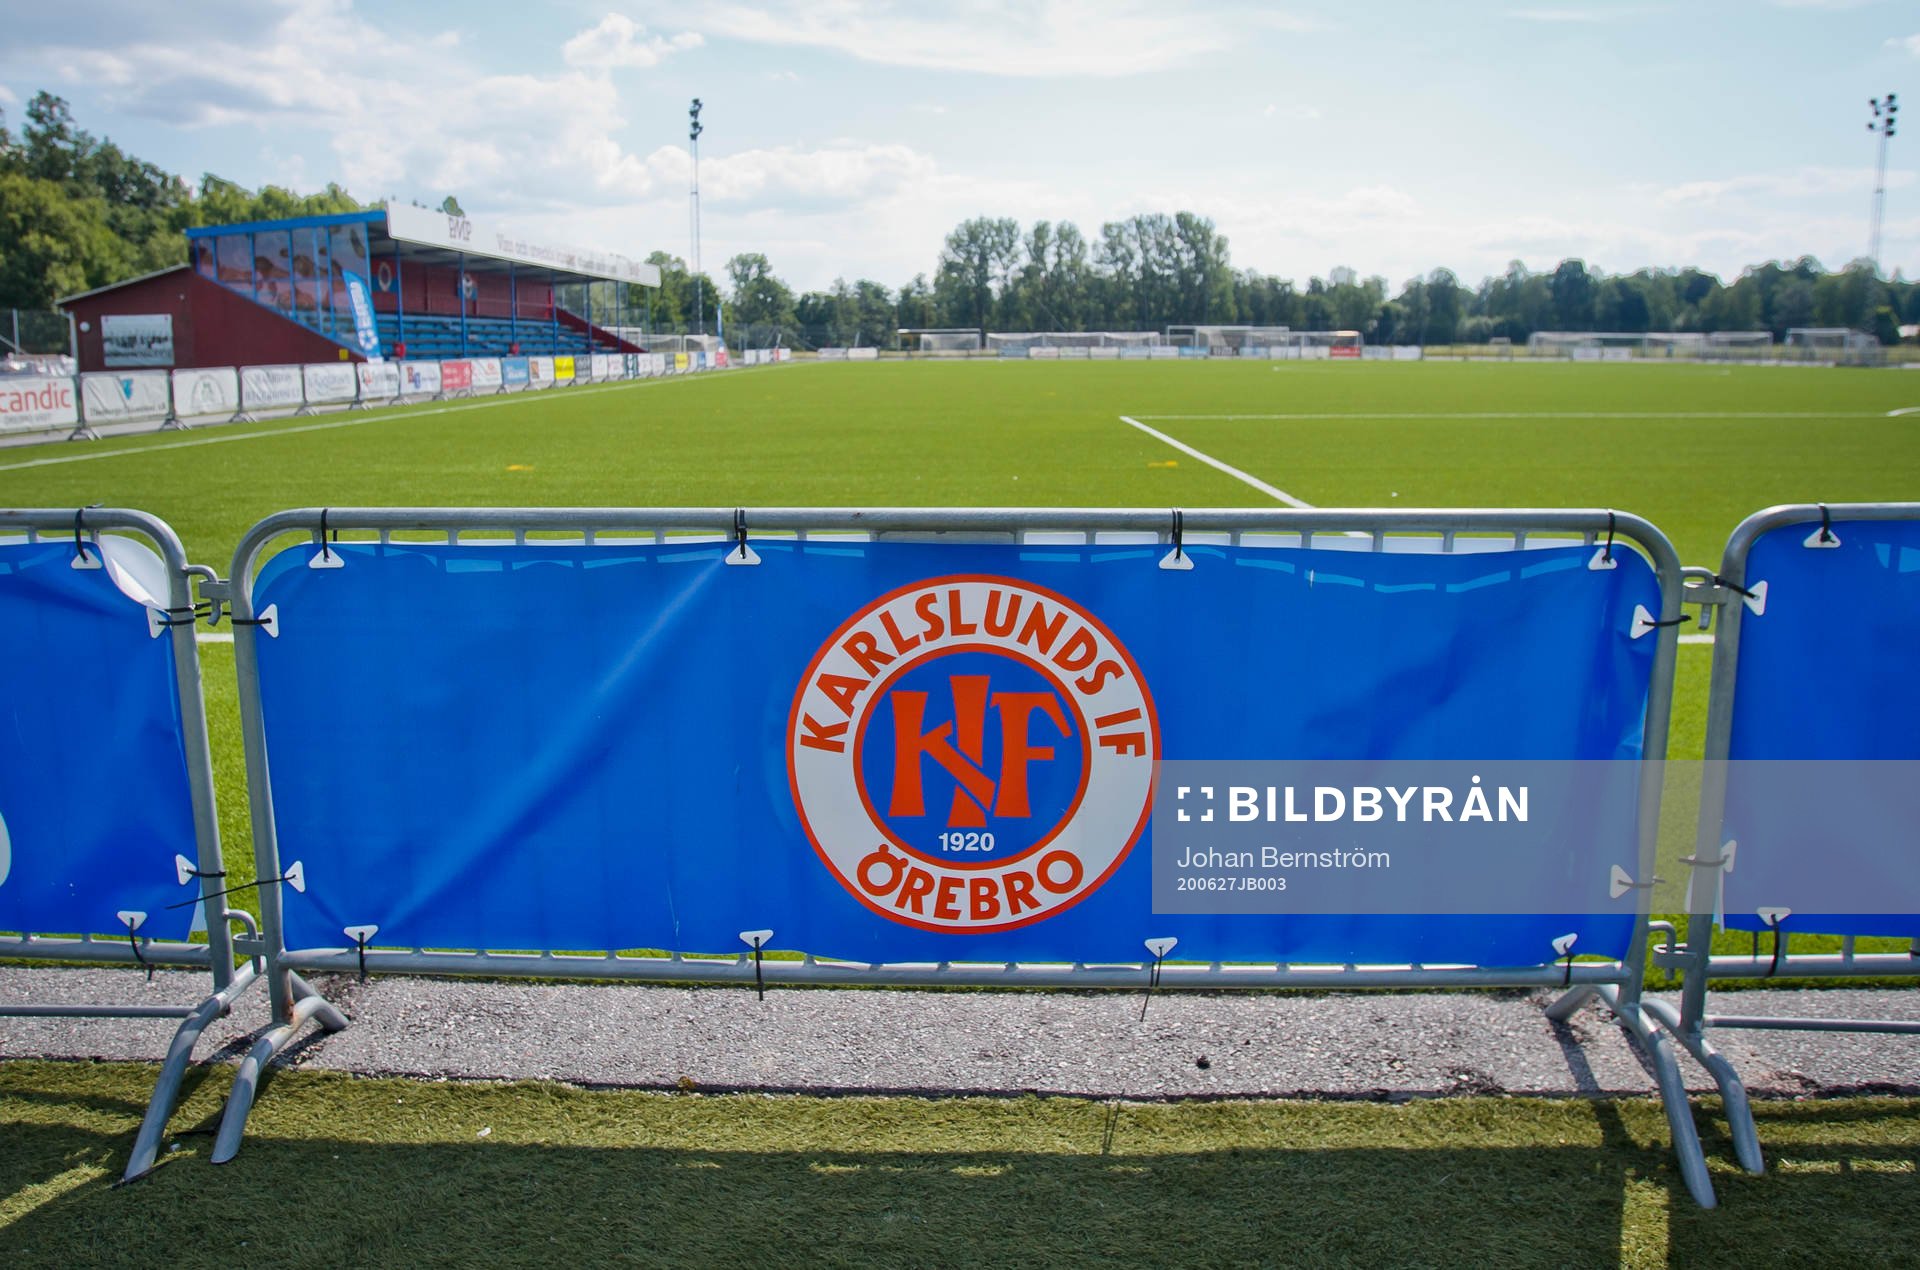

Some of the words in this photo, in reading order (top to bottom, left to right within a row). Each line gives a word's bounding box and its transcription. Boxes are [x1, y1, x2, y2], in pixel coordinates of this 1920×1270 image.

[800, 590, 1123, 753] KARLSLUNDS
[1094, 707, 1146, 757] IF
[938, 832, 995, 852] 1920
[857, 844, 1084, 921] ÖREBRO
